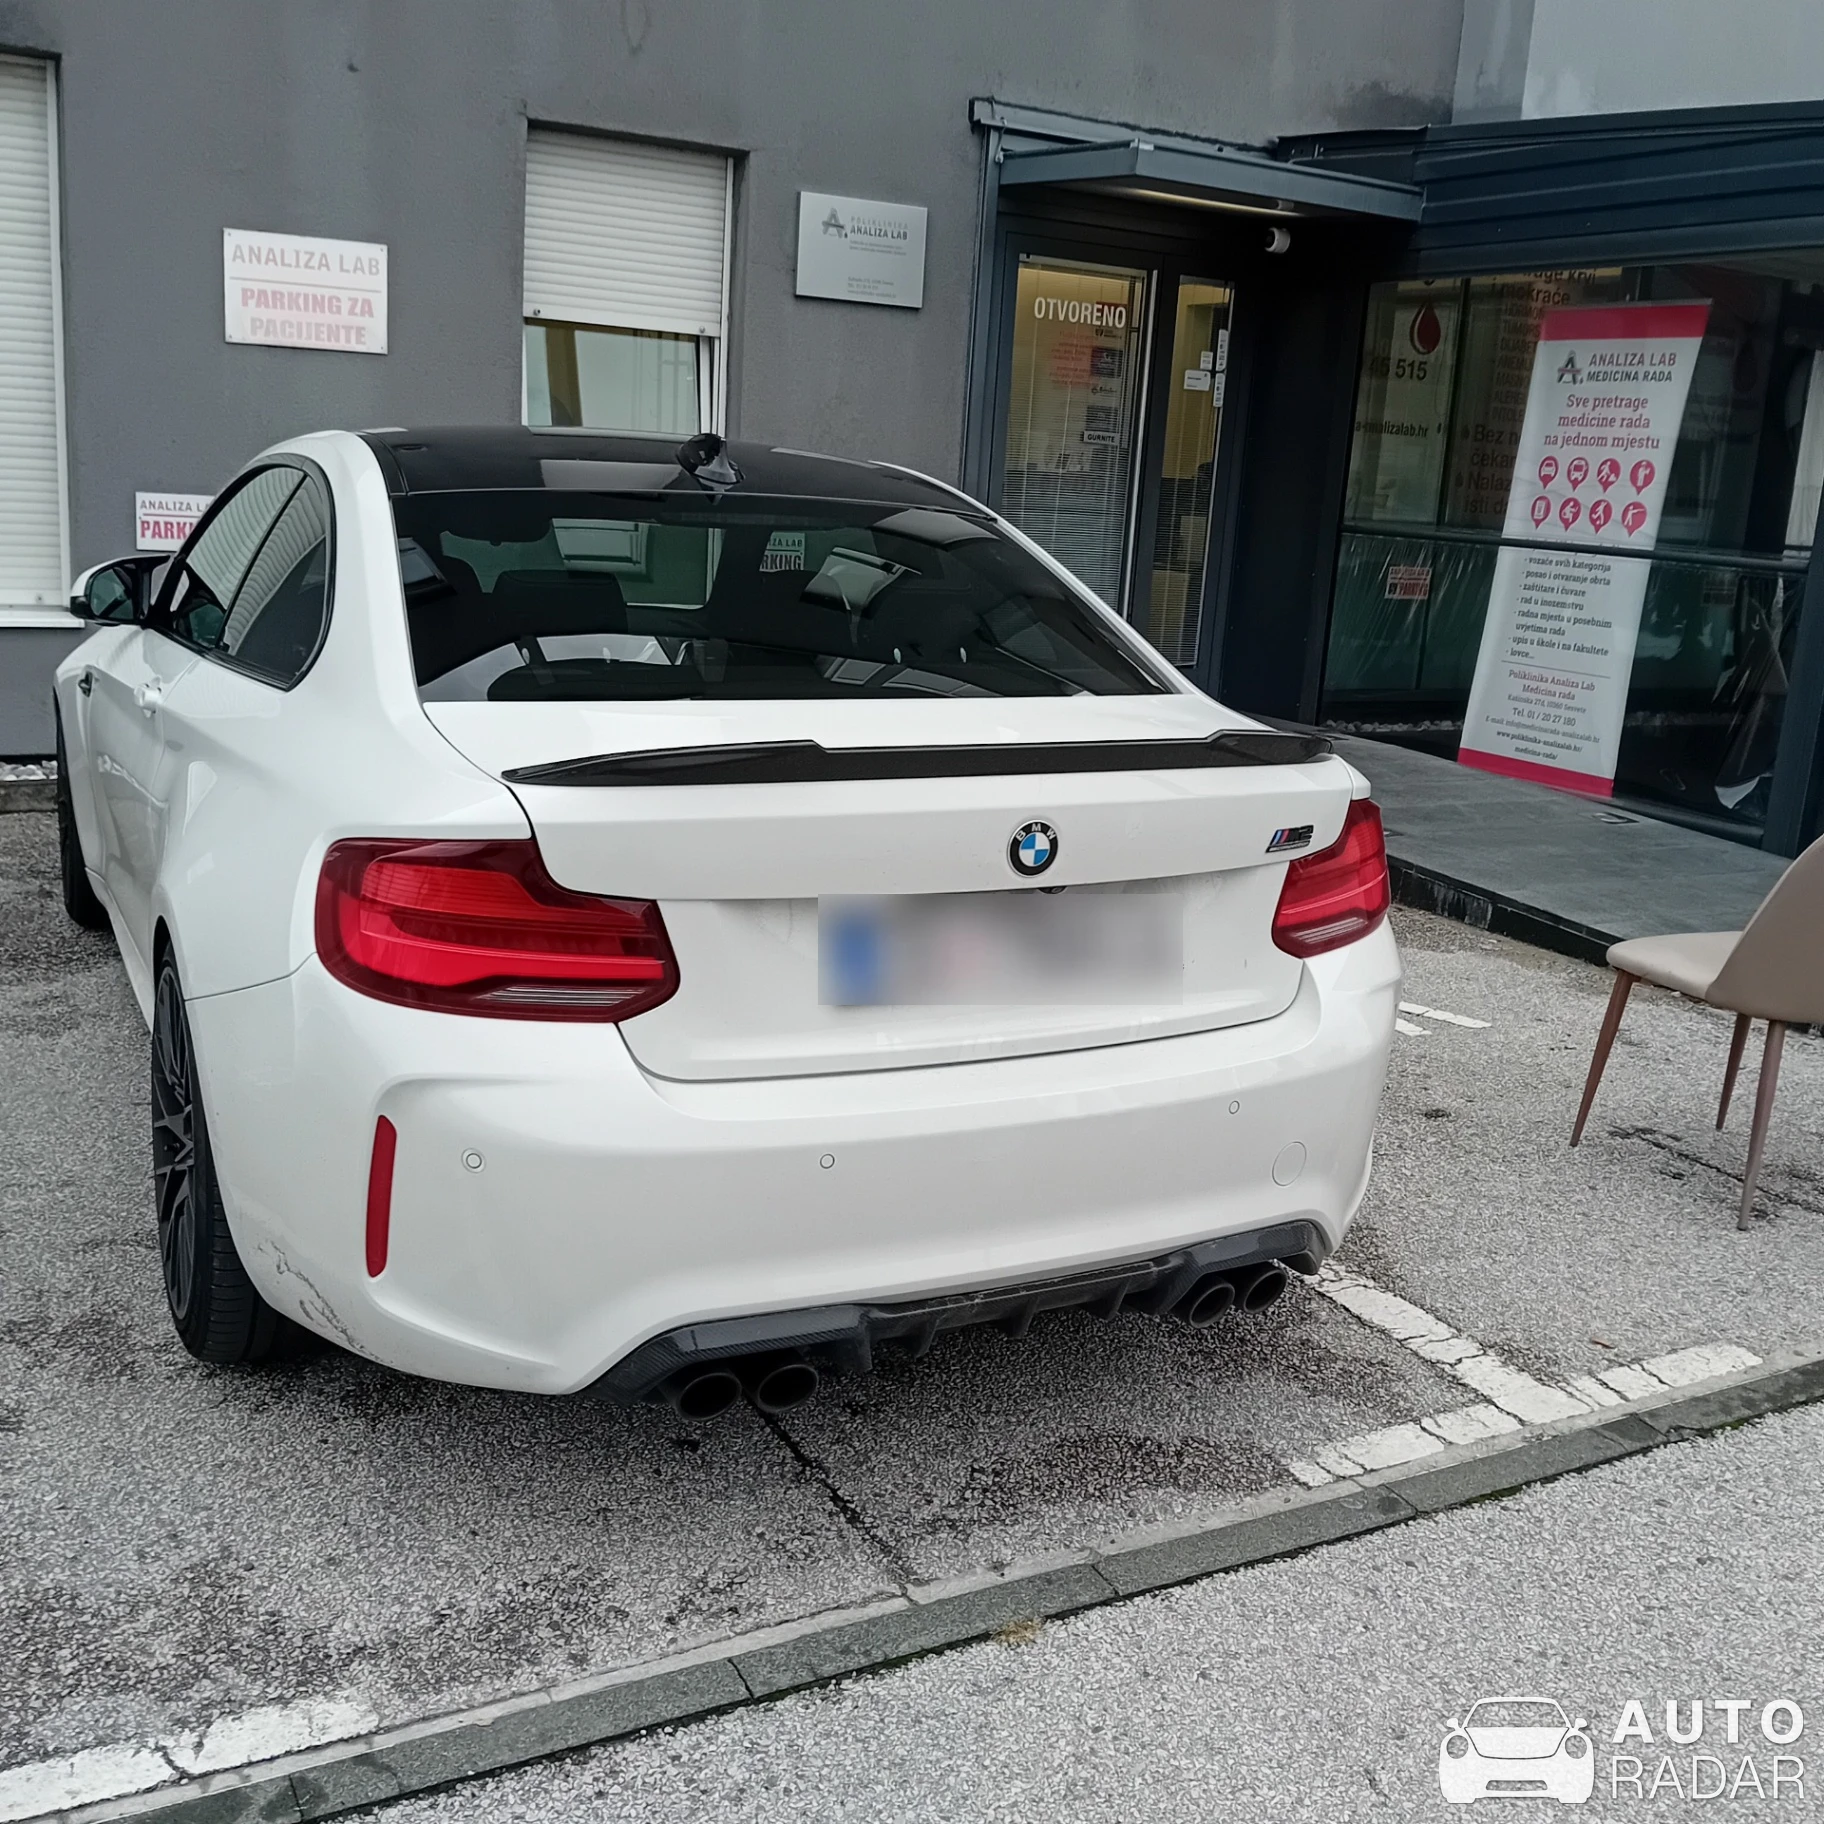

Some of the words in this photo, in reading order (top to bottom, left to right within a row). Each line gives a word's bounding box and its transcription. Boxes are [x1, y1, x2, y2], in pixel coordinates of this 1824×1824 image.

[850, 225, 888, 239] ANALIZA
[891, 230, 907, 240] LAB
[232, 244, 331, 272] ANALIZA
[339, 254, 380, 276] LAB
[241, 287, 342, 316] PARKING
[348, 297, 375, 319] ZA
[1034, 297, 1127, 329] OTVORENO
[250, 317, 367, 346] PACIJENTE
[1589, 353, 1645, 367] ANALIZA
[1650, 353, 1677, 367] LAB
[1395, 358, 1428, 381] 515
[1587, 370, 1639, 382] MEDICINA
[1643, 371, 1673, 382] RADA
[1567, 394, 1589, 408] Sve
[1592, 395, 1648, 412] pretrage
[1558, 413, 1616, 428] medicine
[1620, 414, 1650, 429] rada
[1087, 434, 1115, 443] GURNITE
[1474, 424, 1504, 444] Bez
[1544, 434, 1558, 446] na
[1560, 432, 1607, 449] jednom
[1611, 434, 1660, 451] mjestu
[140, 500, 192, 512] ANALIZA
[786, 539, 803, 547] LAB
[762, 554, 802, 571] RKING
[1555, 558, 1570, 567] svih
[1572, 560, 1611, 573] kategorija
[1525, 570, 1547, 579] posao
[1553, 573, 1588, 584] otvaranje
[1589, 576, 1611, 586] obrta
[1520, 596, 1532, 604] rad
[1540, 598, 1584, 611] inozemstvu
[1518, 609, 1538, 618] radna
[1540, 612, 1565, 622] mjesta
[1572, 616, 1612, 628] posebnim
[1516, 622, 1547, 633] uvjetima
[1549, 627, 1566, 636] rada
[1512, 636, 1528, 646] upis
[1562, 643, 1571, 651] na
[1573, 643, 1609, 656] fakultete
[1509, 669, 1548, 683] Poliklinika
[1550, 676, 1579, 689] Analiza
[1581, 681, 1596, 691] Lab
[1522, 684, 1556, 697] Medicina
[1558, 691, 1576, 701] rada
[1527, 710, 1535, 720] 01
[1541, 713, 1551, 722] 20
[1552, 714, 1562, 724] 27
[1563, 716, 1576, 727] 180
[1016, 823, 1057, 841] BMW
